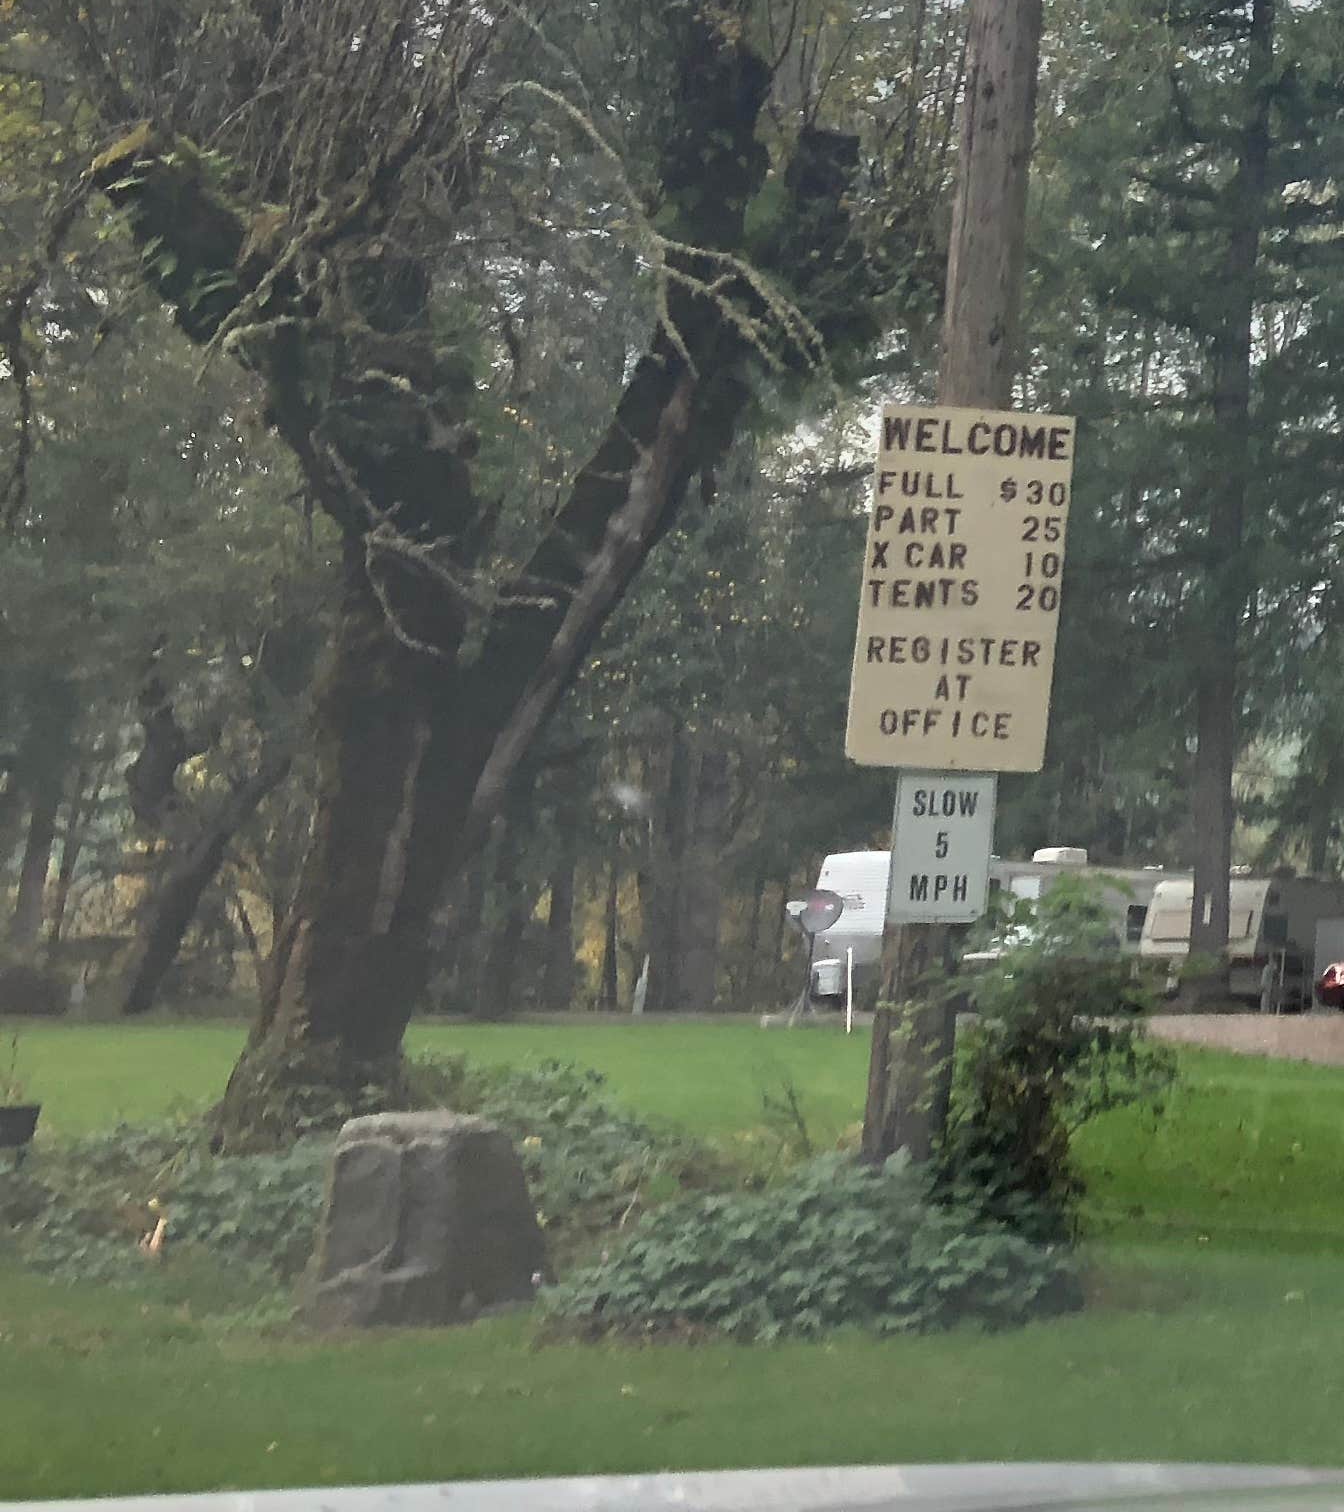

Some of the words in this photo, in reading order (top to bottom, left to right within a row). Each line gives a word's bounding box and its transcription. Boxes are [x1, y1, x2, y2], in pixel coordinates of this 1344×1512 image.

[884, 416, 1070, 460] WELCOME
[879, 471, 963, 498] FULL
[1000, 477, 1066, 506] $30
[874, 505, 961, 535] PART
[1022, 516, 1061, 542] 25
[871, 541, 889, 569] X
[905, 542, 967, 570] CAR
[1025, 552, 1060, 578] 10
[868, 579, 979, 608] TENTS
[1016, 584, 1058, 611] 20
[867, 636, 1041, 666] REGISTER
[935, 674, 972, 701] AT
[880, 709, 1012, 739] OFFICE
[913, 789, 978, 817] SLOW
[935, 831, 948, 858] 5
[910, 874, 967, 901] MPH
